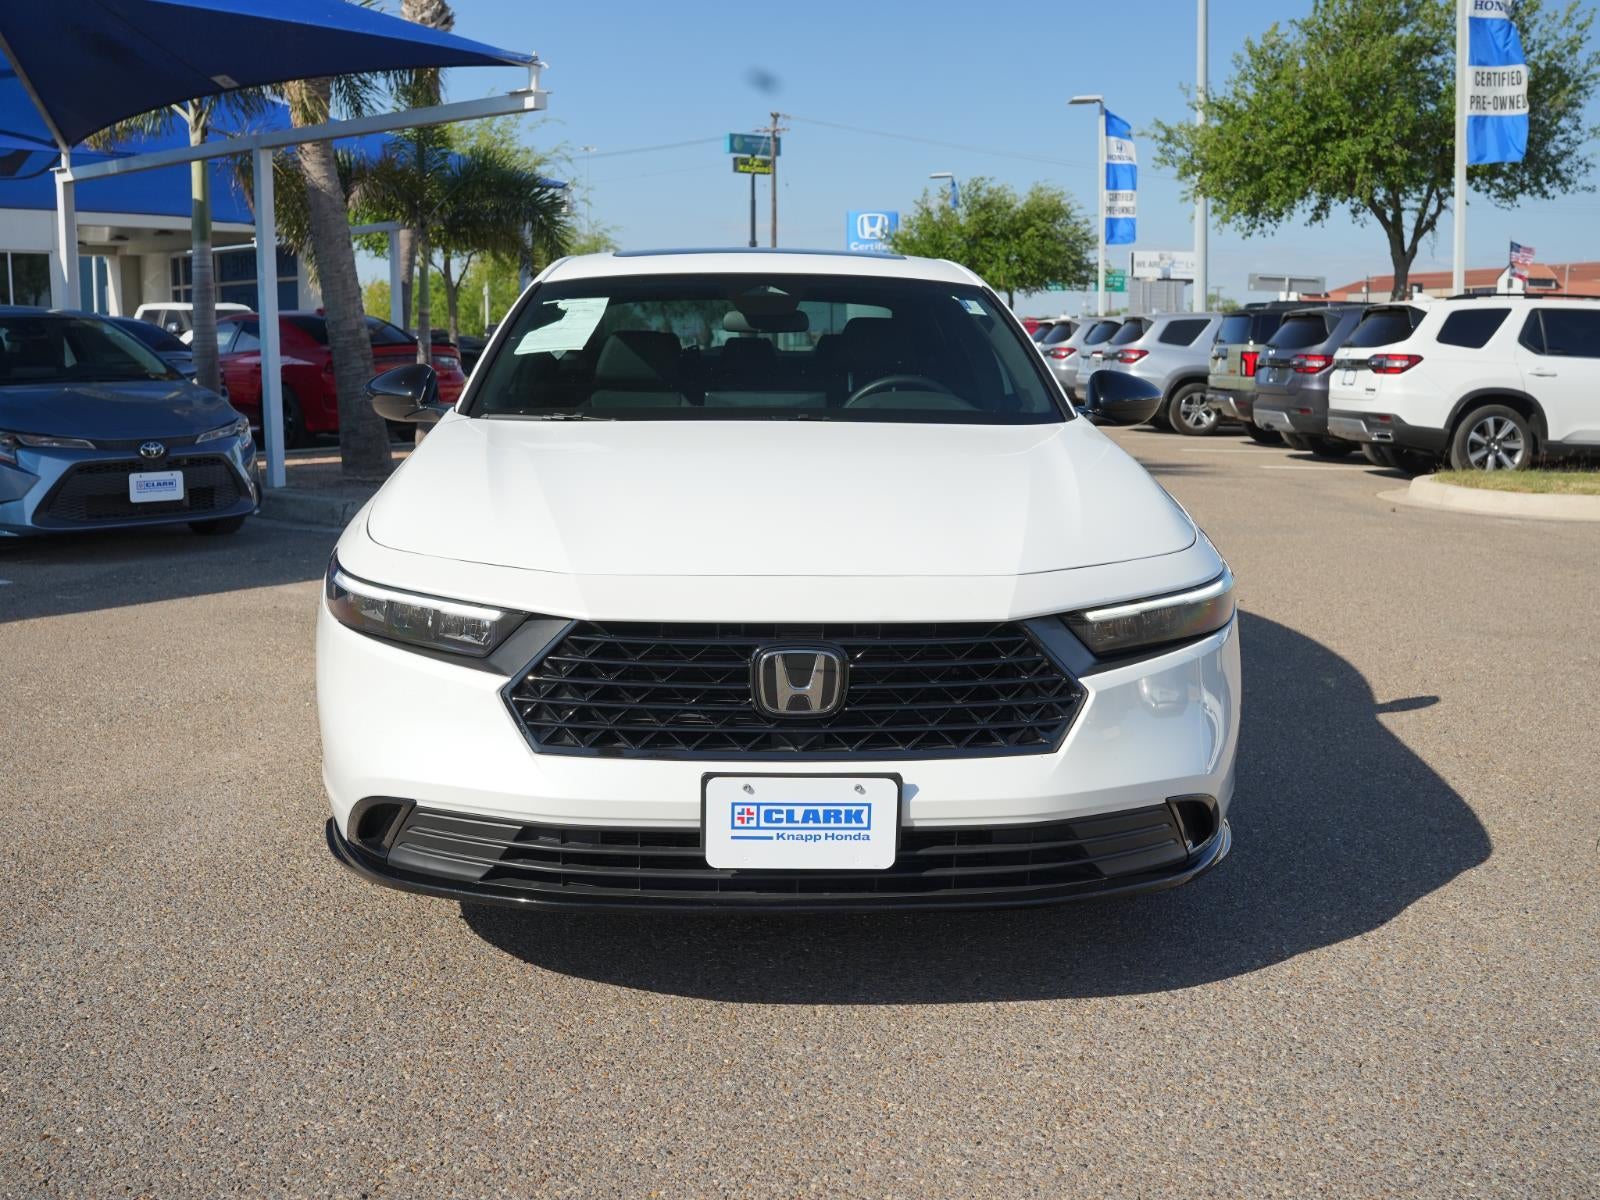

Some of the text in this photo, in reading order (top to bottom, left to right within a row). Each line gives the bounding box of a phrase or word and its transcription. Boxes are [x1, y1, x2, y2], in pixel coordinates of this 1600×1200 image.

[1474, 0, 1504, 11] HON
[1475, 70, 1522, 87] CERTIFIED
[1470, 94, 1528, 110] PRE-OWNED
[763, 808, 865, 825] CLARK
[776, 832, 871, 842] Knapp Honda
